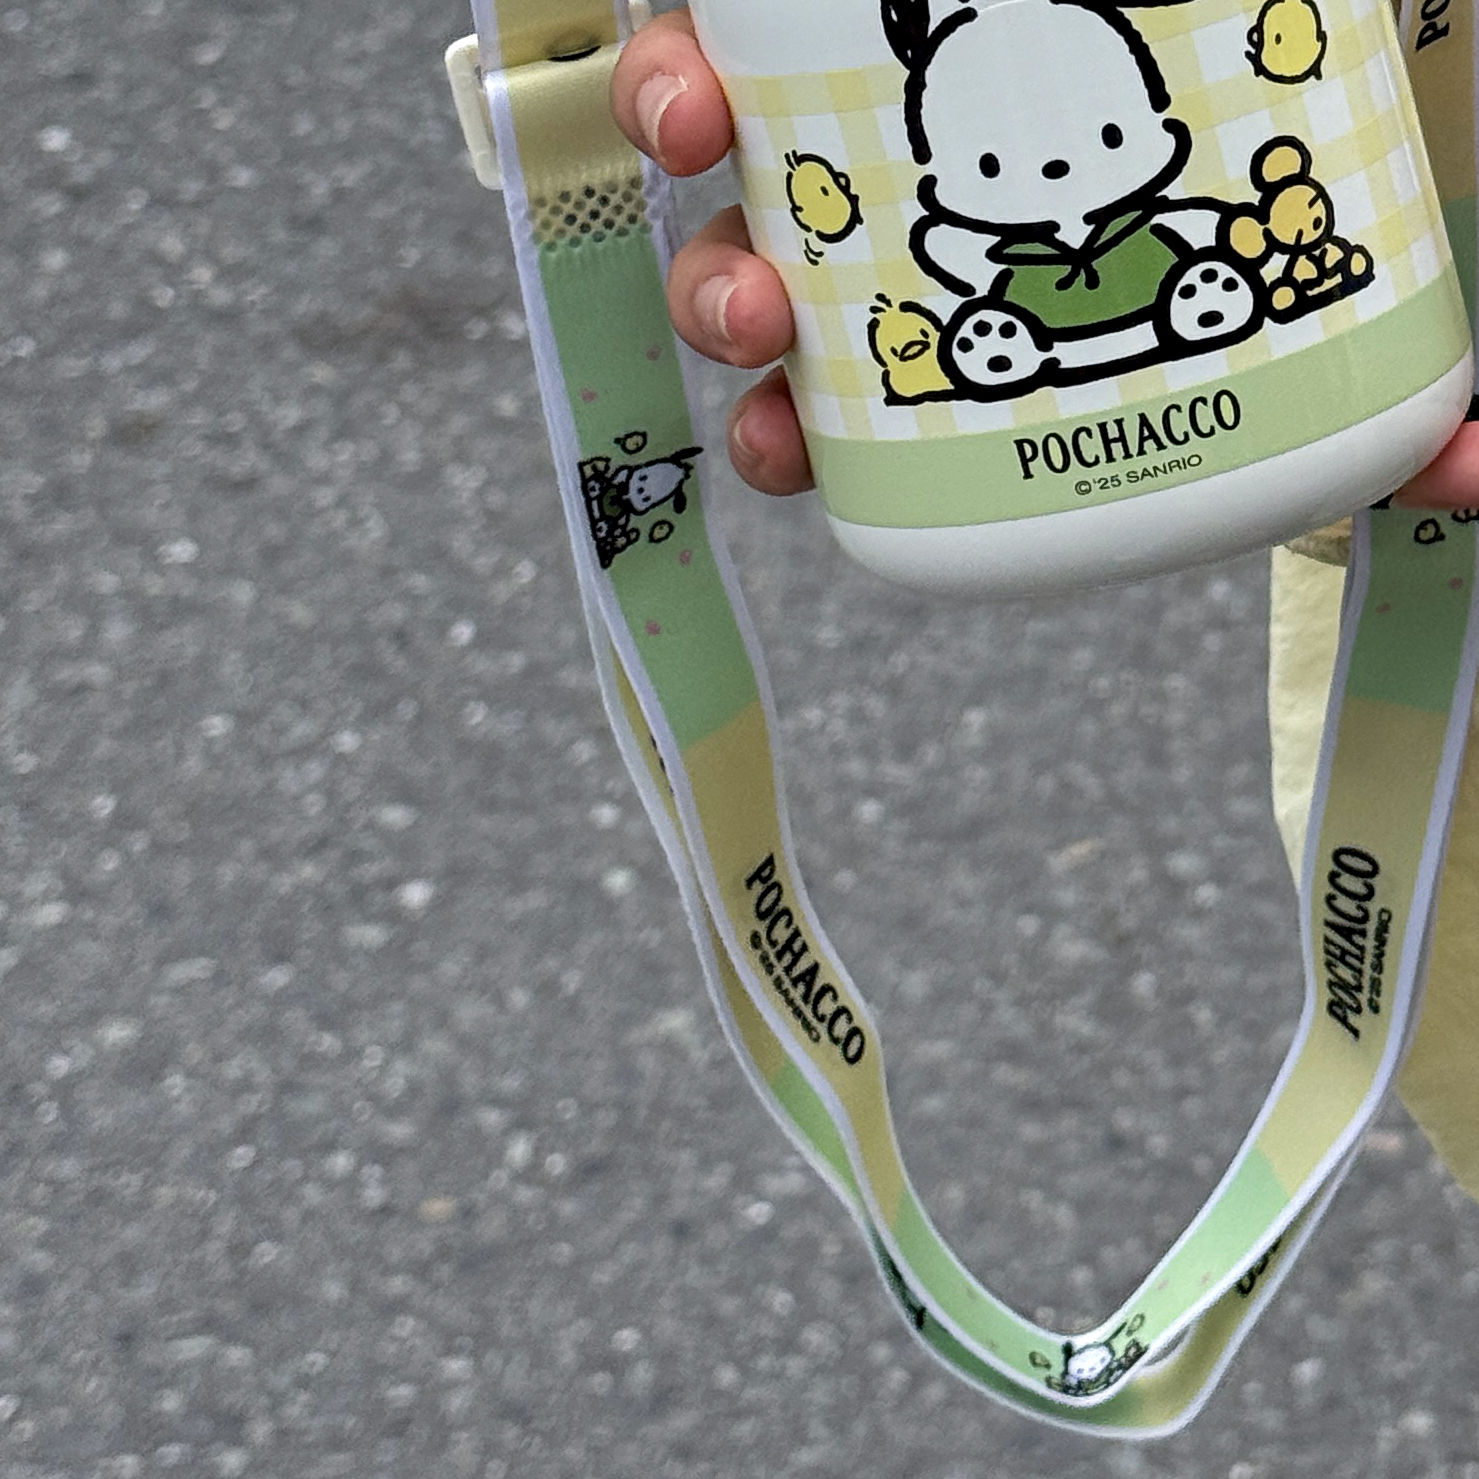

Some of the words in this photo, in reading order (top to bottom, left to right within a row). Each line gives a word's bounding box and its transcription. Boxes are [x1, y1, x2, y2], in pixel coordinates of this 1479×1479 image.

[1013, 389, 1241, 480] POCHACCO
[1126, 453, 1203, 484] SANRIO
[744, 851, 866, 1066] POCHACCO
[1323, 846, 1379, 1041] POCHACCO
